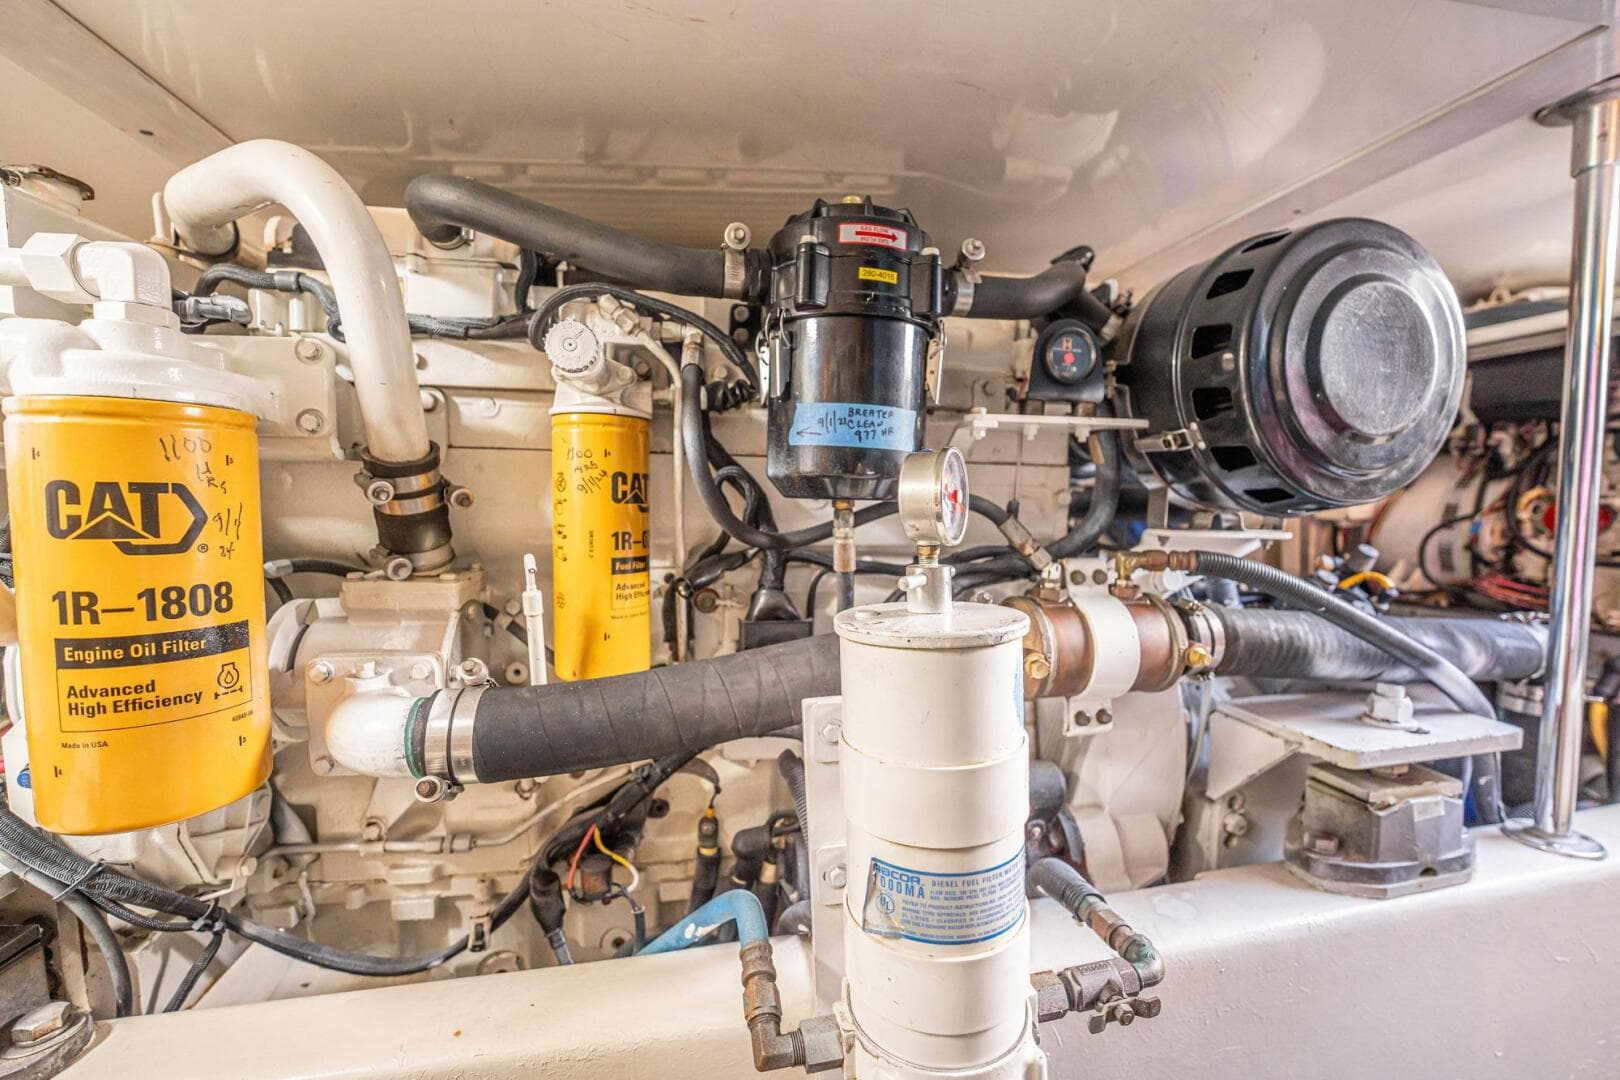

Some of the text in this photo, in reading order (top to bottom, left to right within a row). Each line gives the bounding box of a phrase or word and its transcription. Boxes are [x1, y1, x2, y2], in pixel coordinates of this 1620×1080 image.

[862, 269, 895, 281] 280-4015
[847, 419, 883, 429] CLEAN
[854, 429, 876, 443] 977
[159, 433, 212, 462] 1100
[611, 471, 649, 504] CAT
[45, 479, 171, 540] CAT
[615, 560, 631, 570] Fuel
[616, 592, 633, 601] High
[63, 639, 206, 664] Engine Oil Filter
[67, 679, 156, 699] Advanced
[68, 691, 203, 718] High Efficiency
[931, 879, 958, 888] DIESEL
[962, 879, 979, 888] FUEL
